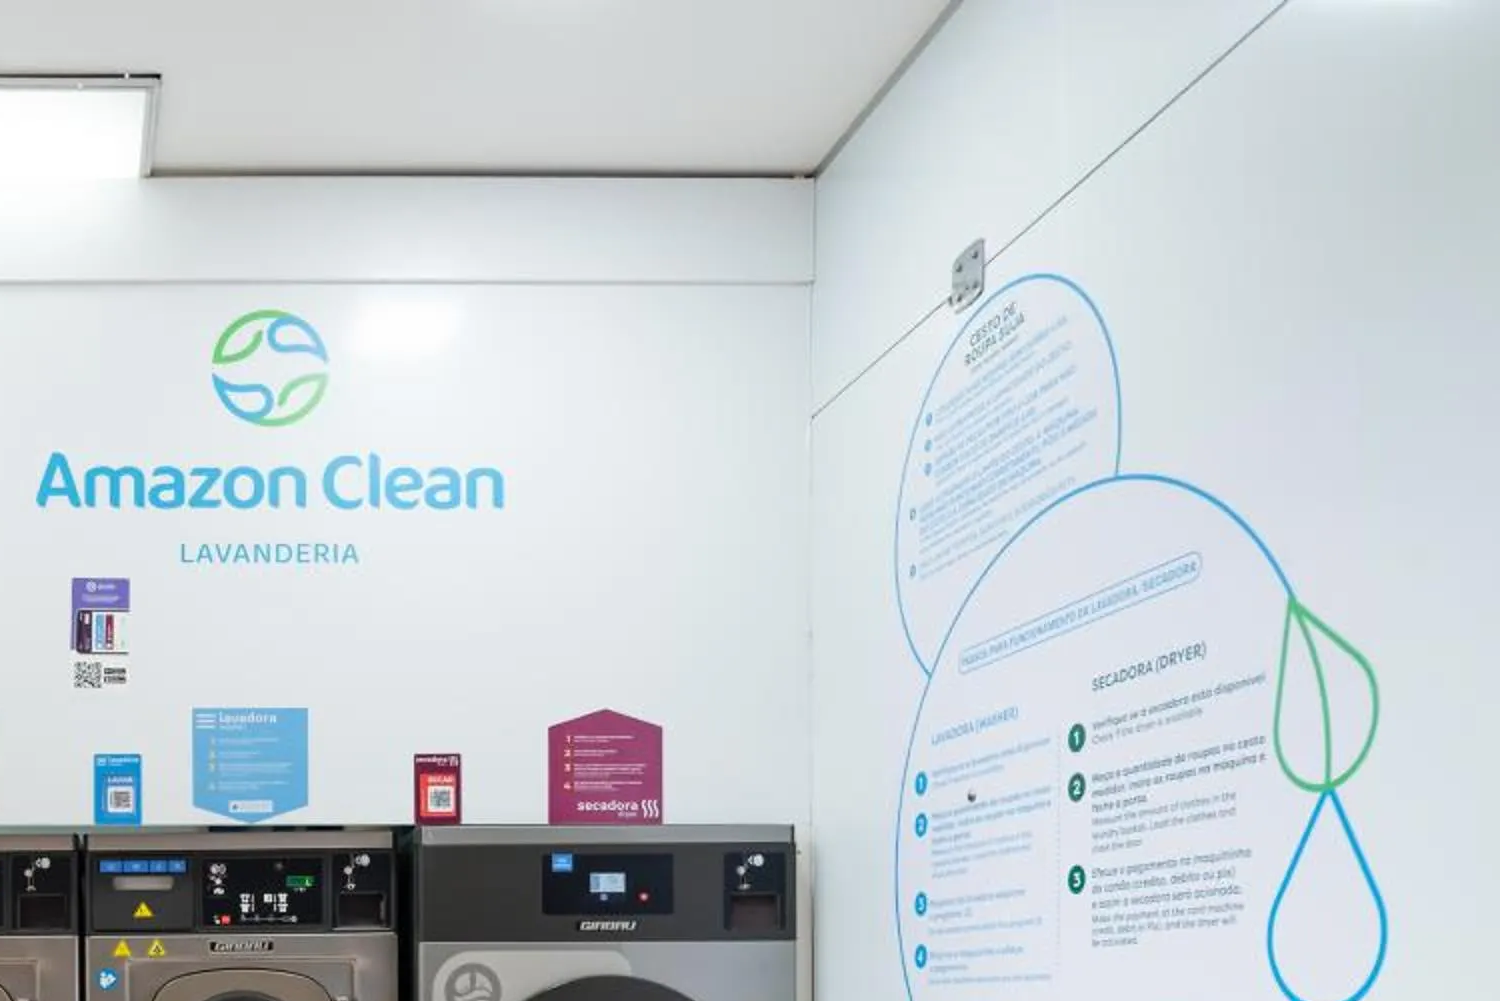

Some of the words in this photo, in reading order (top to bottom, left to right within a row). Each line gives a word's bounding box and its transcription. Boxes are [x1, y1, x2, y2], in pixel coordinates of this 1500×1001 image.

[36, 451, 307, 510] Amazon
[322, 451, 505, 510] Clean
[180, 543, 359, 564] LAVANDERIA
[1092, 660, 1153, 691] SECADORA
[1155, 640, 1207, 674] (DRYER)
[577, 799, 639, 811] secadora
